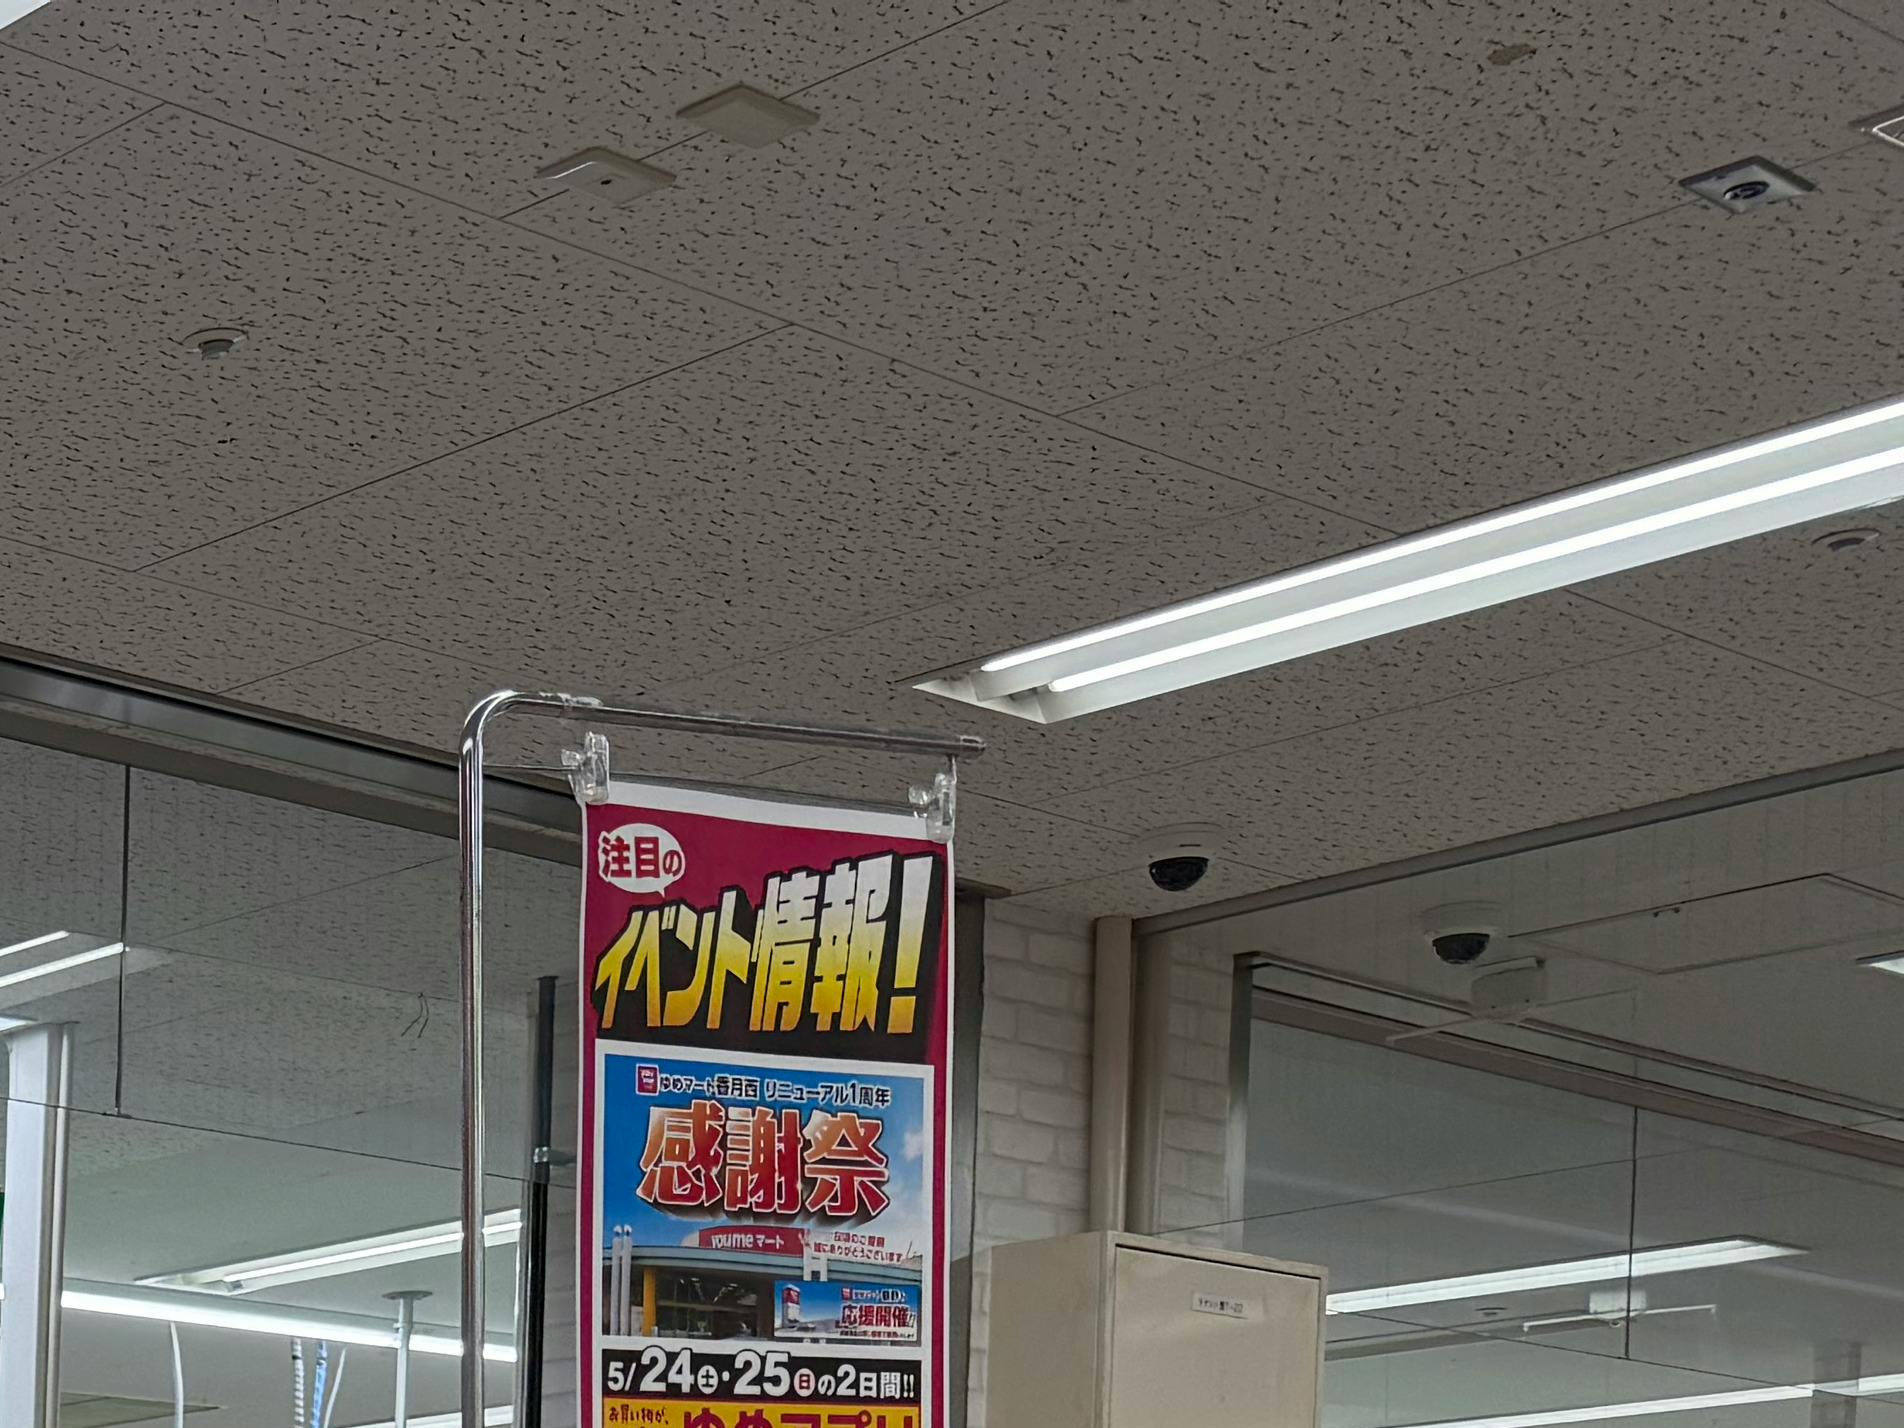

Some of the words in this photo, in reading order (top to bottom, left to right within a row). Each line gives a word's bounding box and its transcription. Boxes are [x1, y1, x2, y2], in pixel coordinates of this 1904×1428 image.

[598, 834, 682, 881] 注目の
[594, 854, 934, 1035] イベント情報!
[765, 1081, 892, 1107] リニューアル1周年
[636, 1099, 890, 1217] 感謝祭
